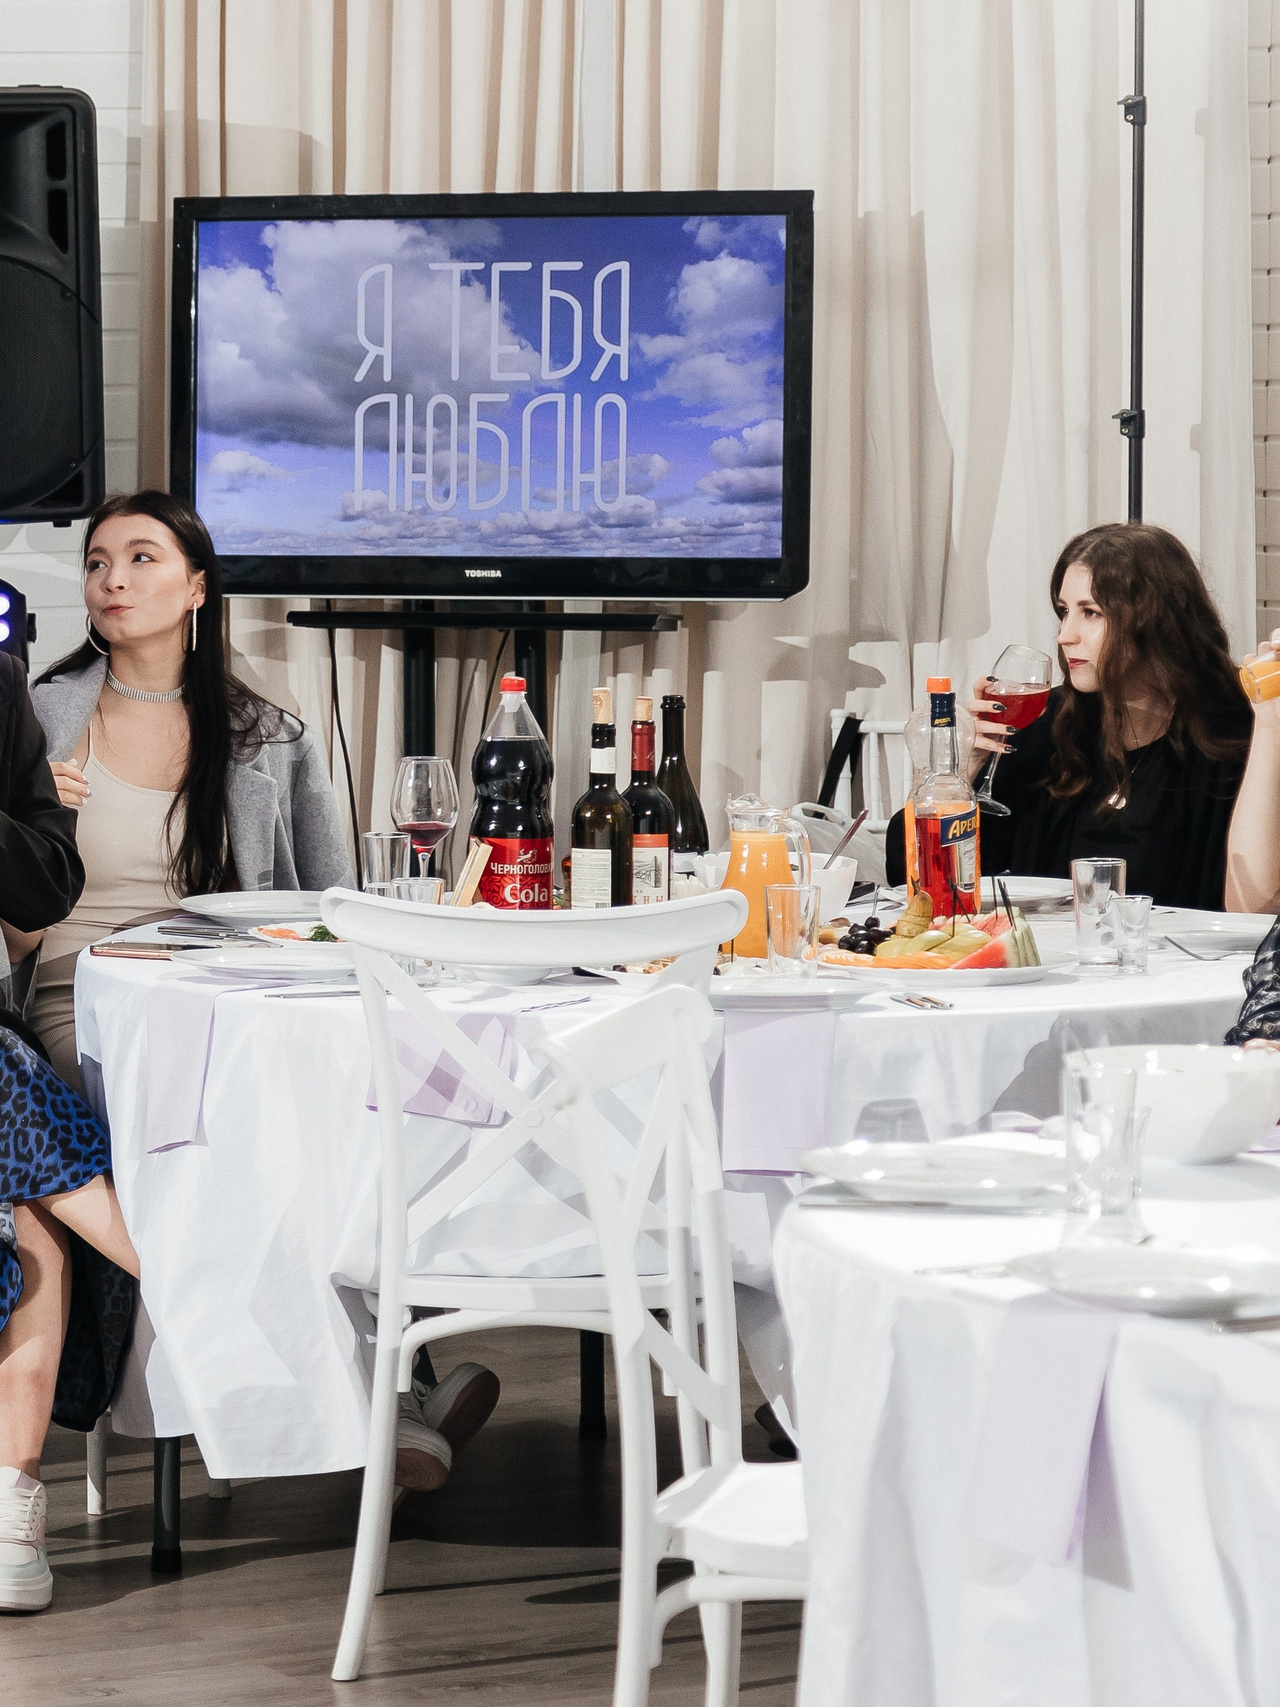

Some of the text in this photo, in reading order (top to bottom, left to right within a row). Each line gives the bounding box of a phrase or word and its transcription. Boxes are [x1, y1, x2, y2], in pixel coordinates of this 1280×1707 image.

[354, 260, 630, 383] Я ТЕБЯ
[354, 392, 628, 513] ЛЮБЛЮ
[464, 569, 502, 578] TOSHIBA
[504, 882, 548, 904] Cola
